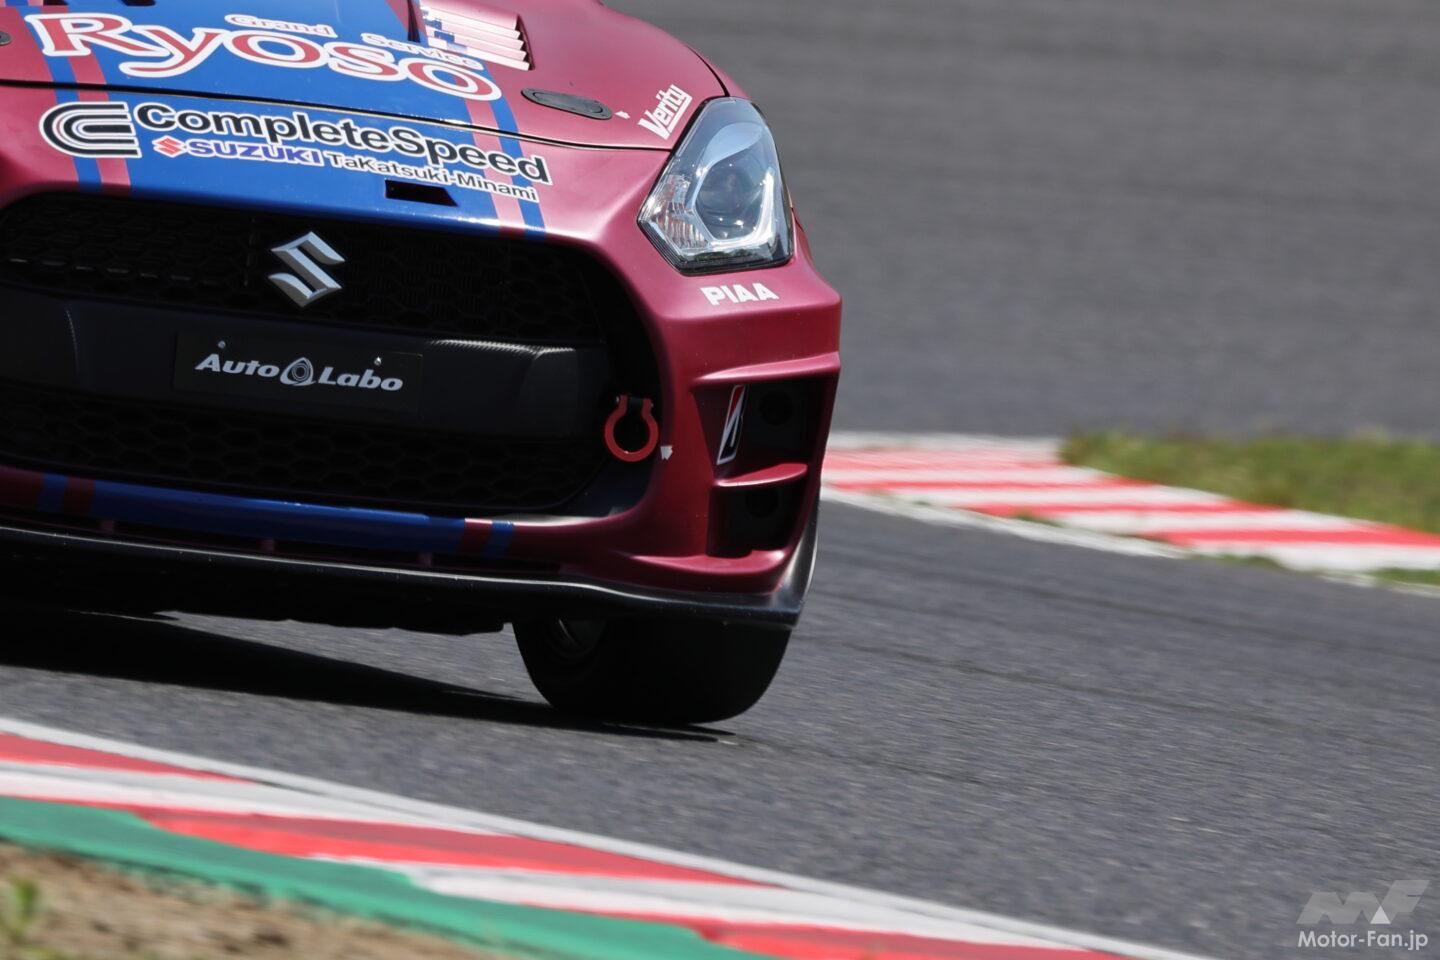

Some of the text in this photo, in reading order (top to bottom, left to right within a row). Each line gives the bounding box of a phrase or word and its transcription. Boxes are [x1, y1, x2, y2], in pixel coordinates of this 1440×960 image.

[24, 12, 502, 102] Ryoso
[224, 14, 485, 71] Grand Service
[638, 84, 693, 140] Verity
[185, 138, 324, 166] SUZUKI
[700, 282, 779, 306] PIAA
[195, 353, 403, 391] Auto Labo
